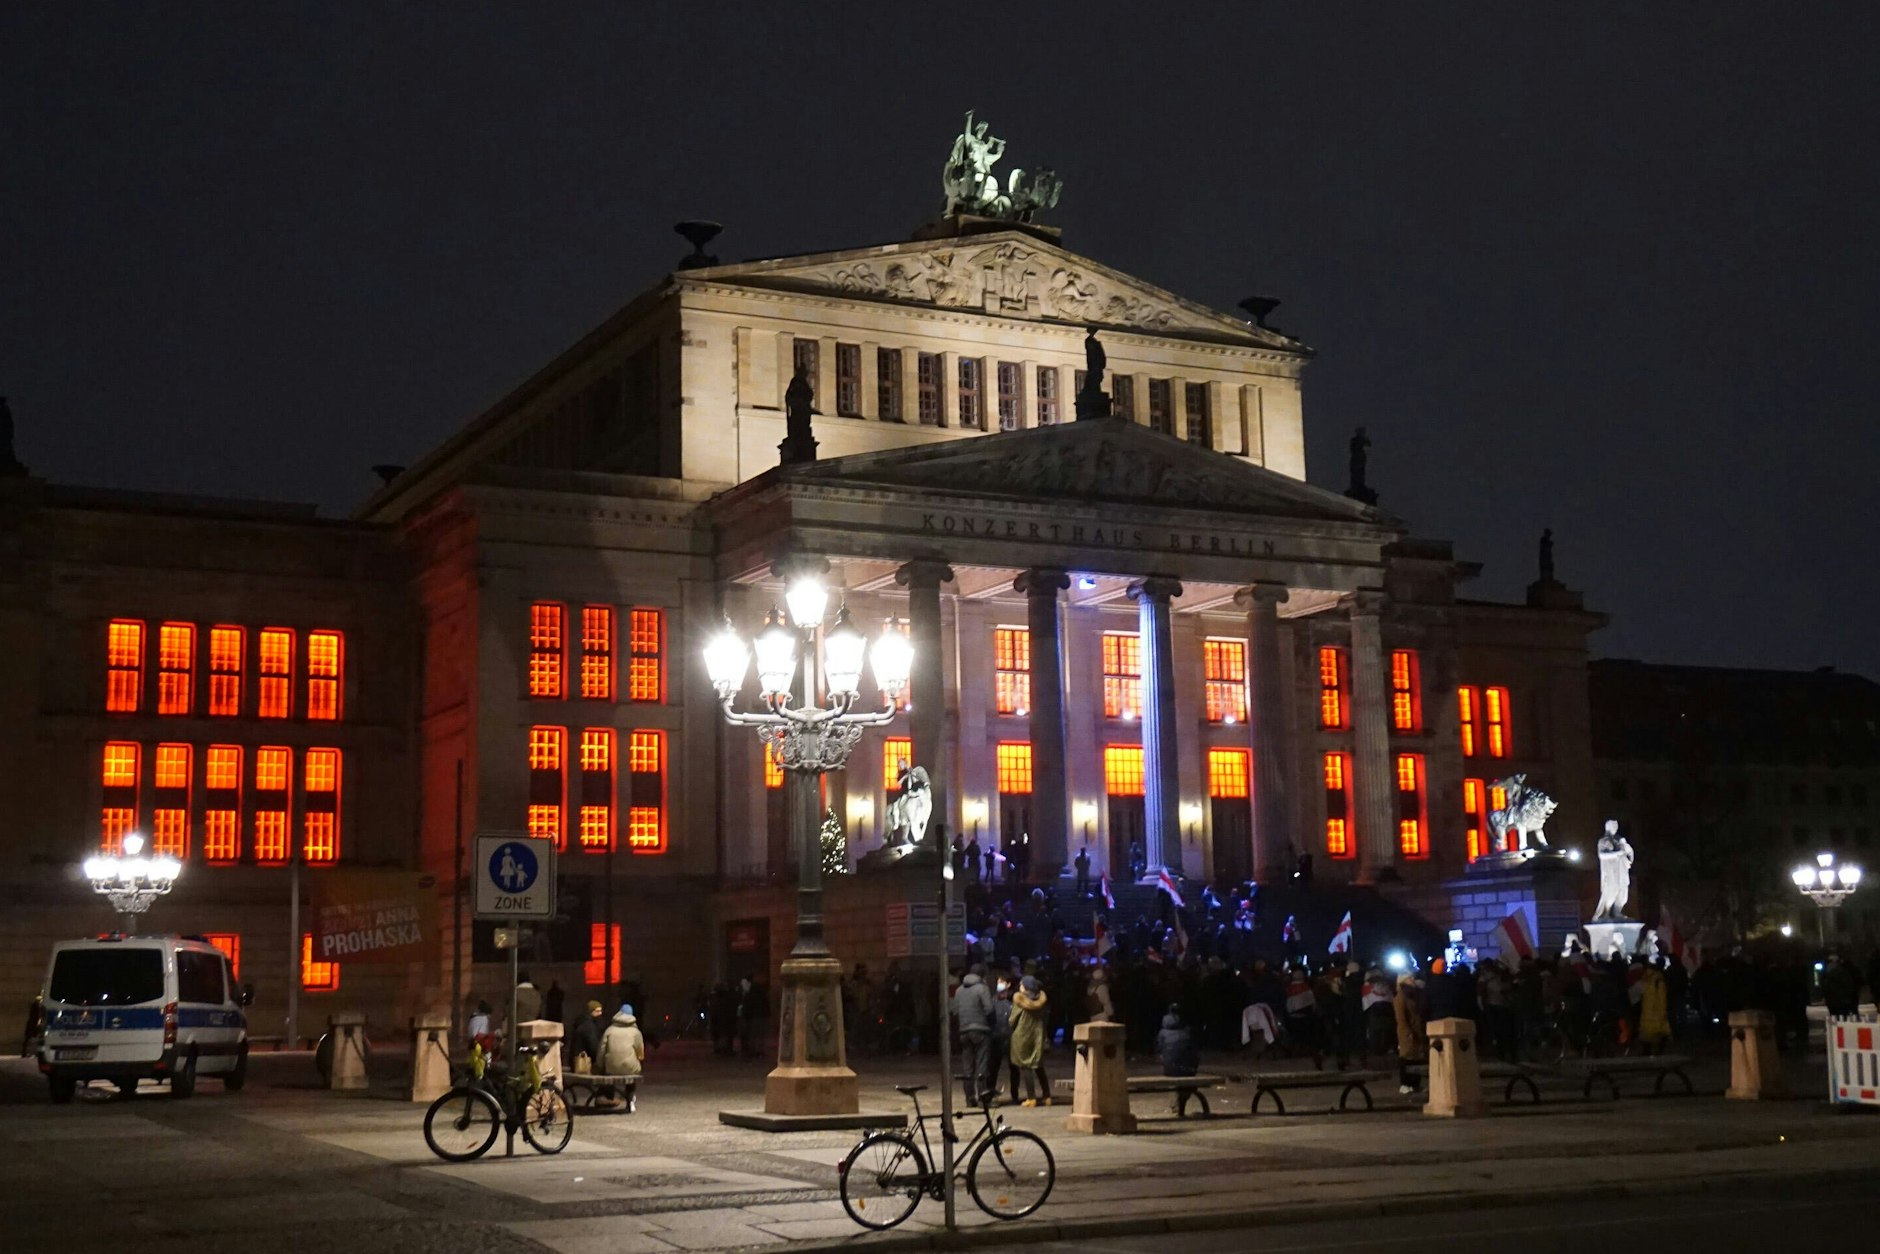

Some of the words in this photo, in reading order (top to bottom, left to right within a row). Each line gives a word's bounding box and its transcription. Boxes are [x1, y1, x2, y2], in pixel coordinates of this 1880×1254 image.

[923, 514, 1143, 546] KONZERTHAUS
[1169, 533, 1276, 555] BERLIN
[376, 905, 421, 927] ANNA
[494, 896, 532, 909] ZONE
[322, 922, 423, 956] PROHASKA
